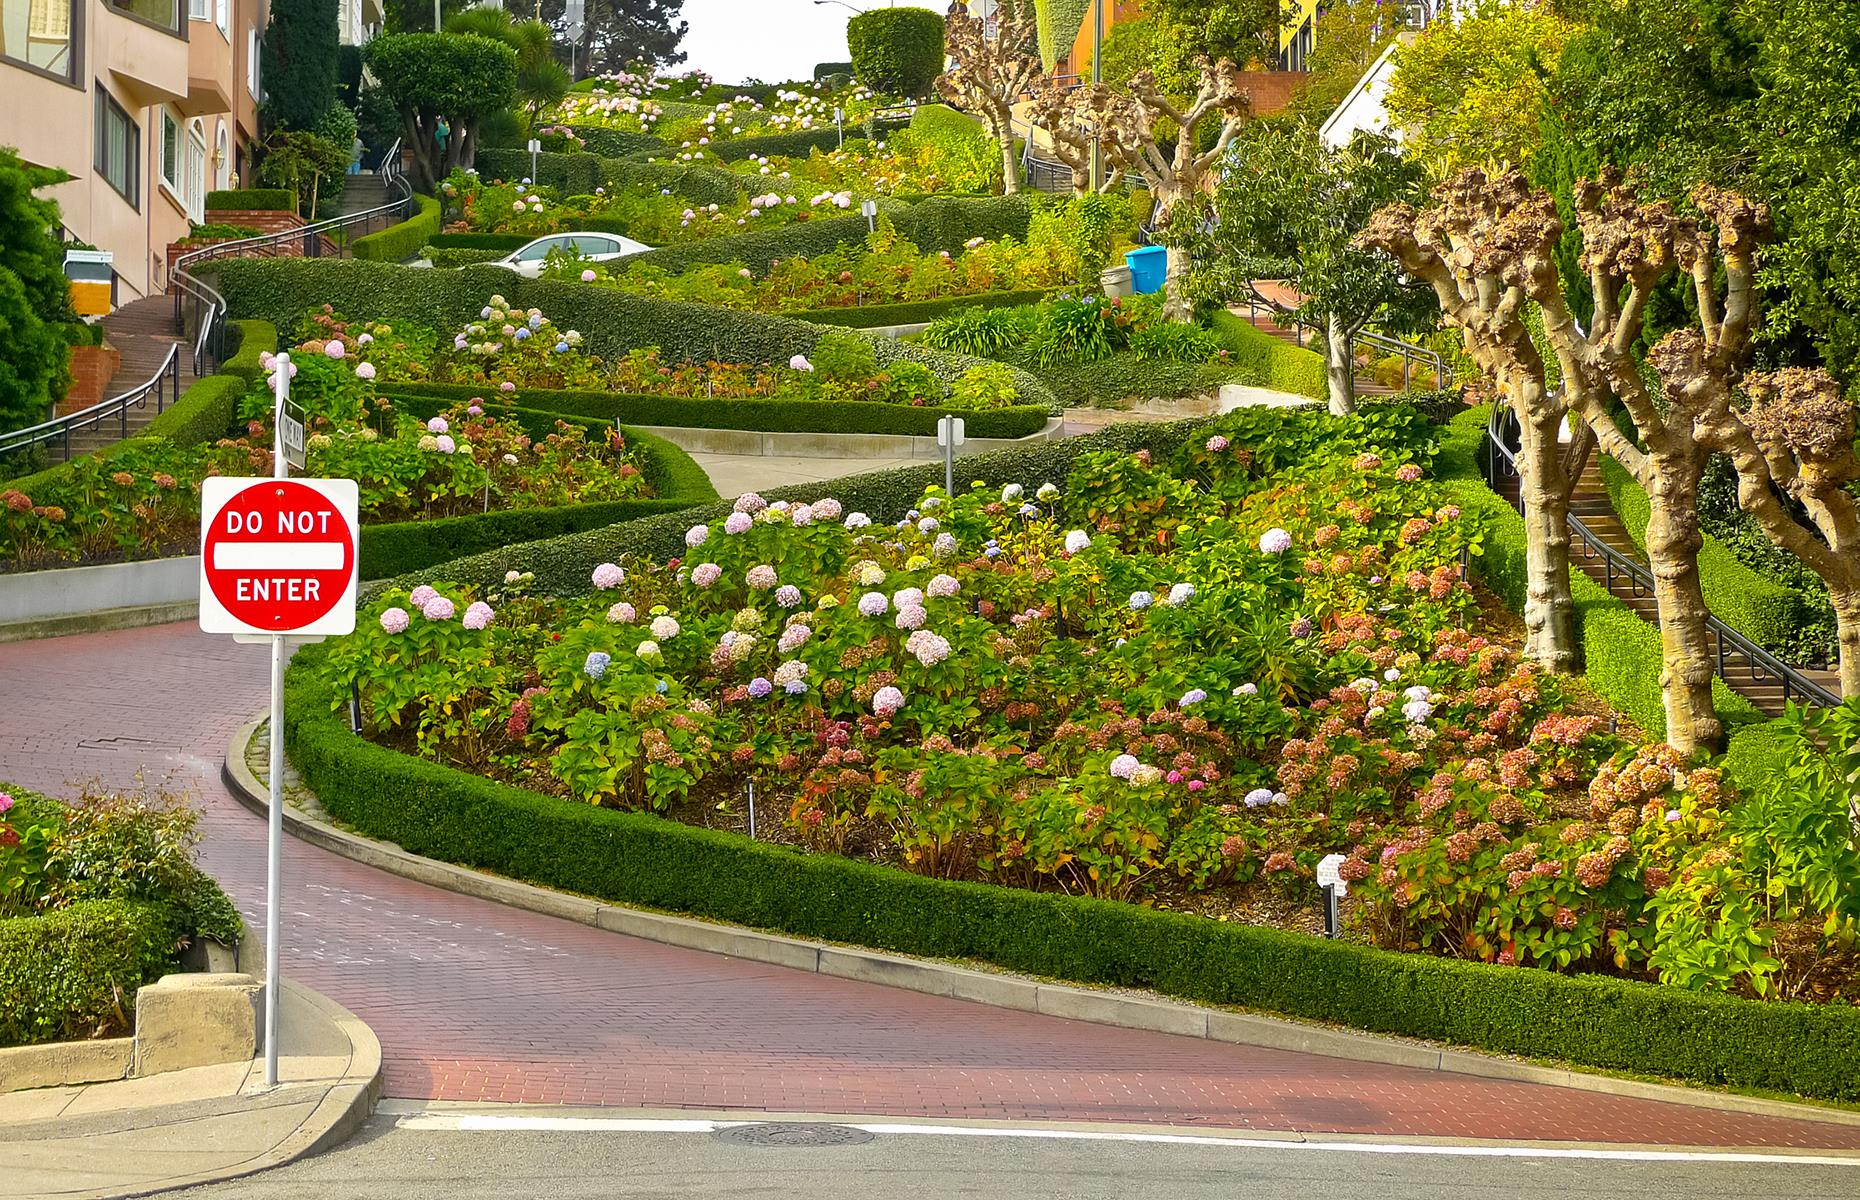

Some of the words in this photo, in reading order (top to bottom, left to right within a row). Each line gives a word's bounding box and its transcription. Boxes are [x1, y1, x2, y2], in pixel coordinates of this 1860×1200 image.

[227, 511, 263, 534] DO
[278, 511, 332, 534] NOT
[236, 578, 320, 601] ENTER
